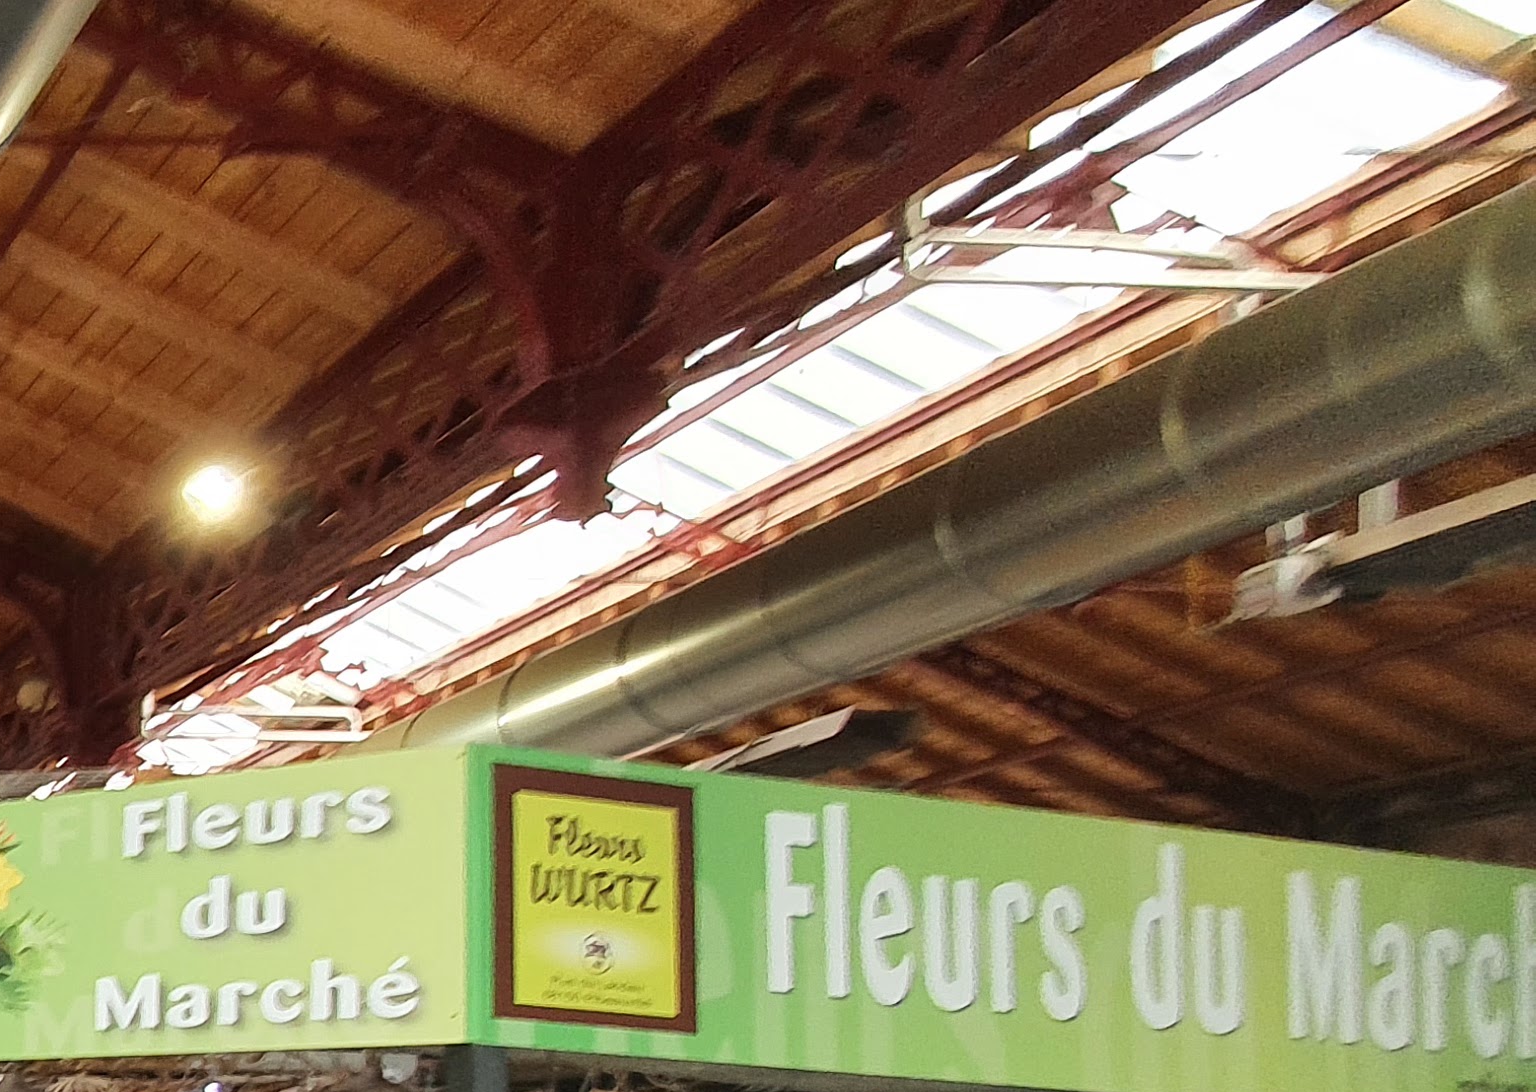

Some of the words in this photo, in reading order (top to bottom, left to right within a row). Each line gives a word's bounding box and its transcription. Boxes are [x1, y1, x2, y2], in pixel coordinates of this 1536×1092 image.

[122, 784, 393, 861] Fleurs
[546, 813, 646, 864] Fleurs
[181, 875, 287, 940] du
[529, 861, 661, 914] WURTZ
[763, 803, 1088, 1022] Fleurs
[1130, 842, 1245, 1036] du
[93, 955, 421, 1033] Marché
